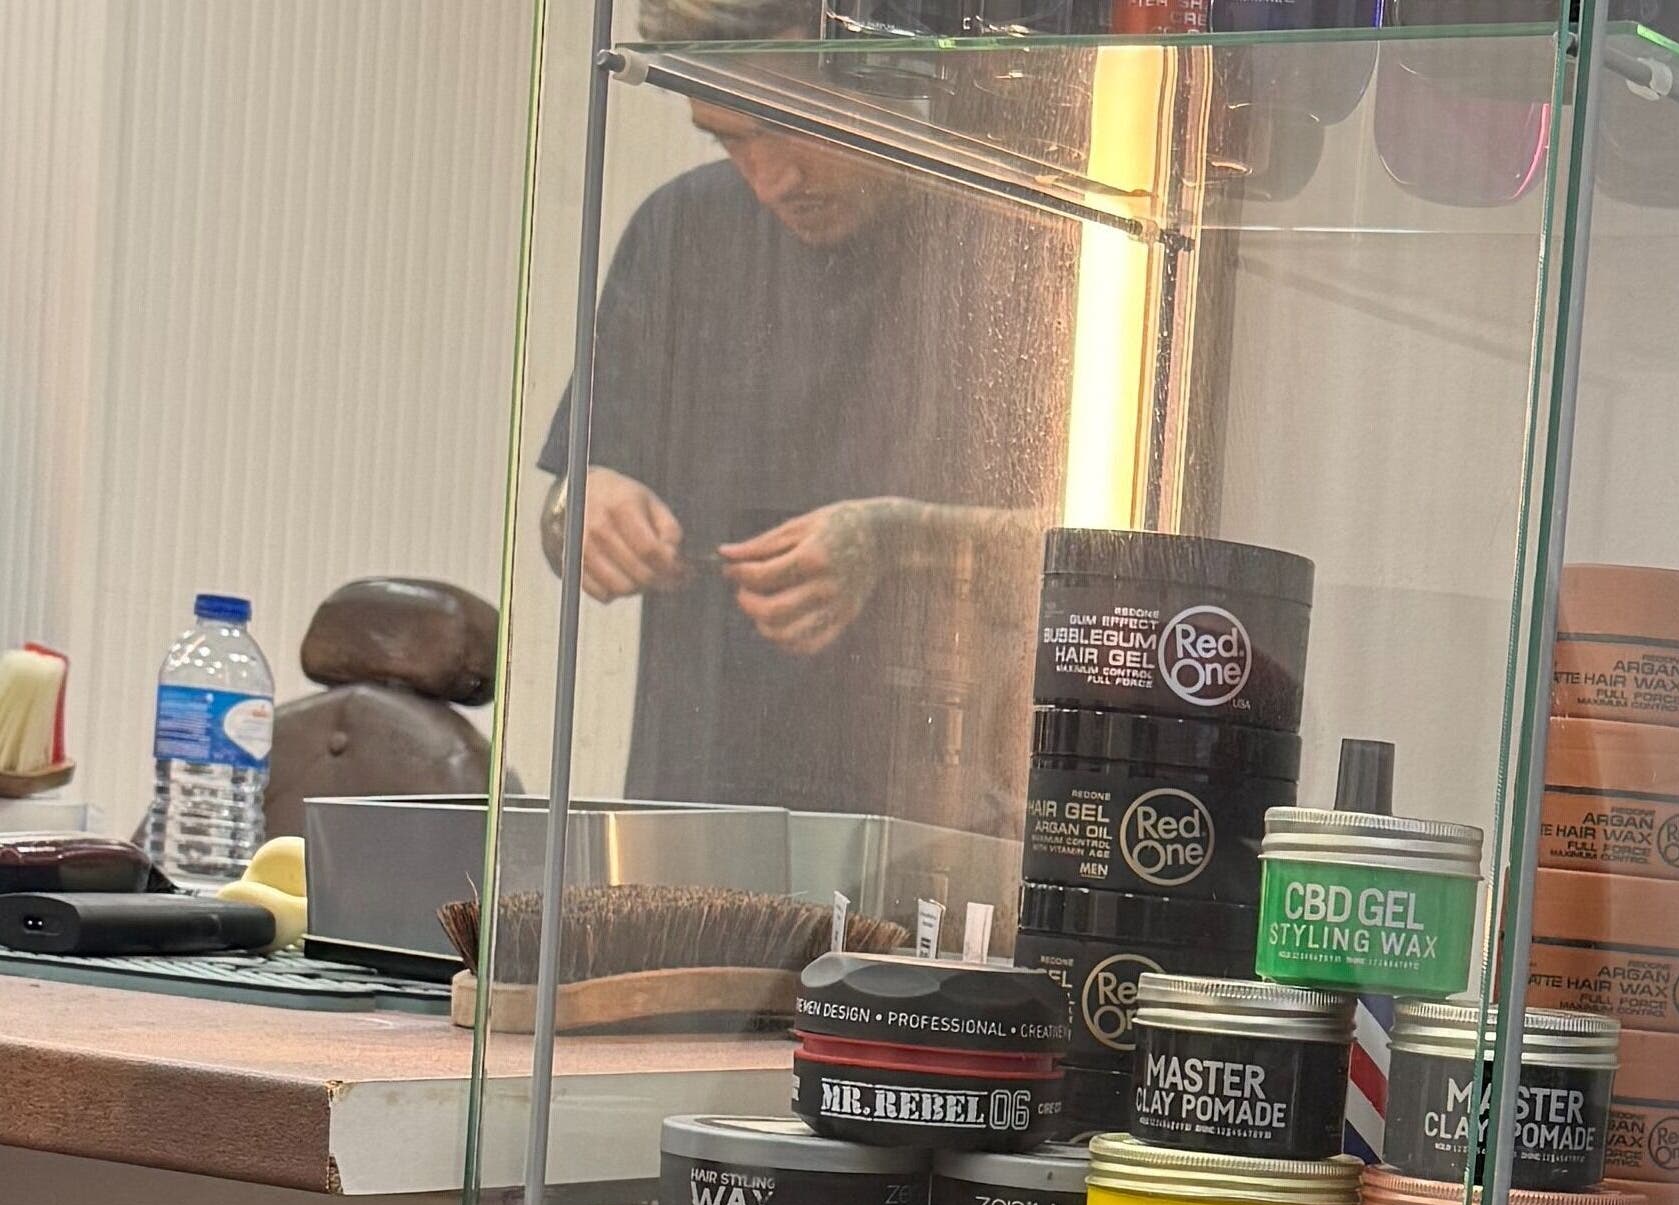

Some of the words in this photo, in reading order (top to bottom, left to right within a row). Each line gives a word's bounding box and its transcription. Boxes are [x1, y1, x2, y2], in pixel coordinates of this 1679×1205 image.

[1044, 627, 1157, 649] BUBBLEGUM
[1055, 646, 1098, 664] HAIR
[1109, 649, 1155, 668] GEL
[1170, 658, 1241, 694] One
[1553, 671, 1581, 685] ATTE
[1584, 673, 1626, 687] HAIR
[1065, 803, 1110, 823] GEL
[1583, 812, 1654, 830] ARGAN
[1035, 821, 1080, 836] ARGAN
[1086, 825, 1112, 840] OIL
[1556, 824, 1596, 840] HAIR
[1603, 828, 1652, 846] WAX
[1132, 839, 1203, 874] One
[1080, 862, 1108, 876] MEN
[1285, 882, 1352, 923] CBD
[1358, 888, 1424, 930] GEL
[1269, 921, 1370, 953] STYLING
[1381, 931, 1438, 959] WAX
[1528, 973, 1563, 988] ATTE
[1566, 977, 1612, 992] HAIR
[1619, 982, 1668, 998] WAX
[1597, 966, 1671, 984] ARGAN
[1098, 971, 1137, 1005] Re
[823, 1002, 871, 1023] DESIGN
[888, 1011, 1007, 1037] PROFESSIONAL
[1146, 1053, 1266, 1099] MASTER
[820, 1083, 870, 1116] MR.
[873, 1088, 985, 1124] REBEL
[989, 1089, 1031, 1131] 06
[1136, 1087, 1175, 1116] CLAY
[1181, 1093, 1287, 1128] POMADE
[691, 1167, 717, 1184] HAIR
[720, 1172, 776, 1190] STYLING
